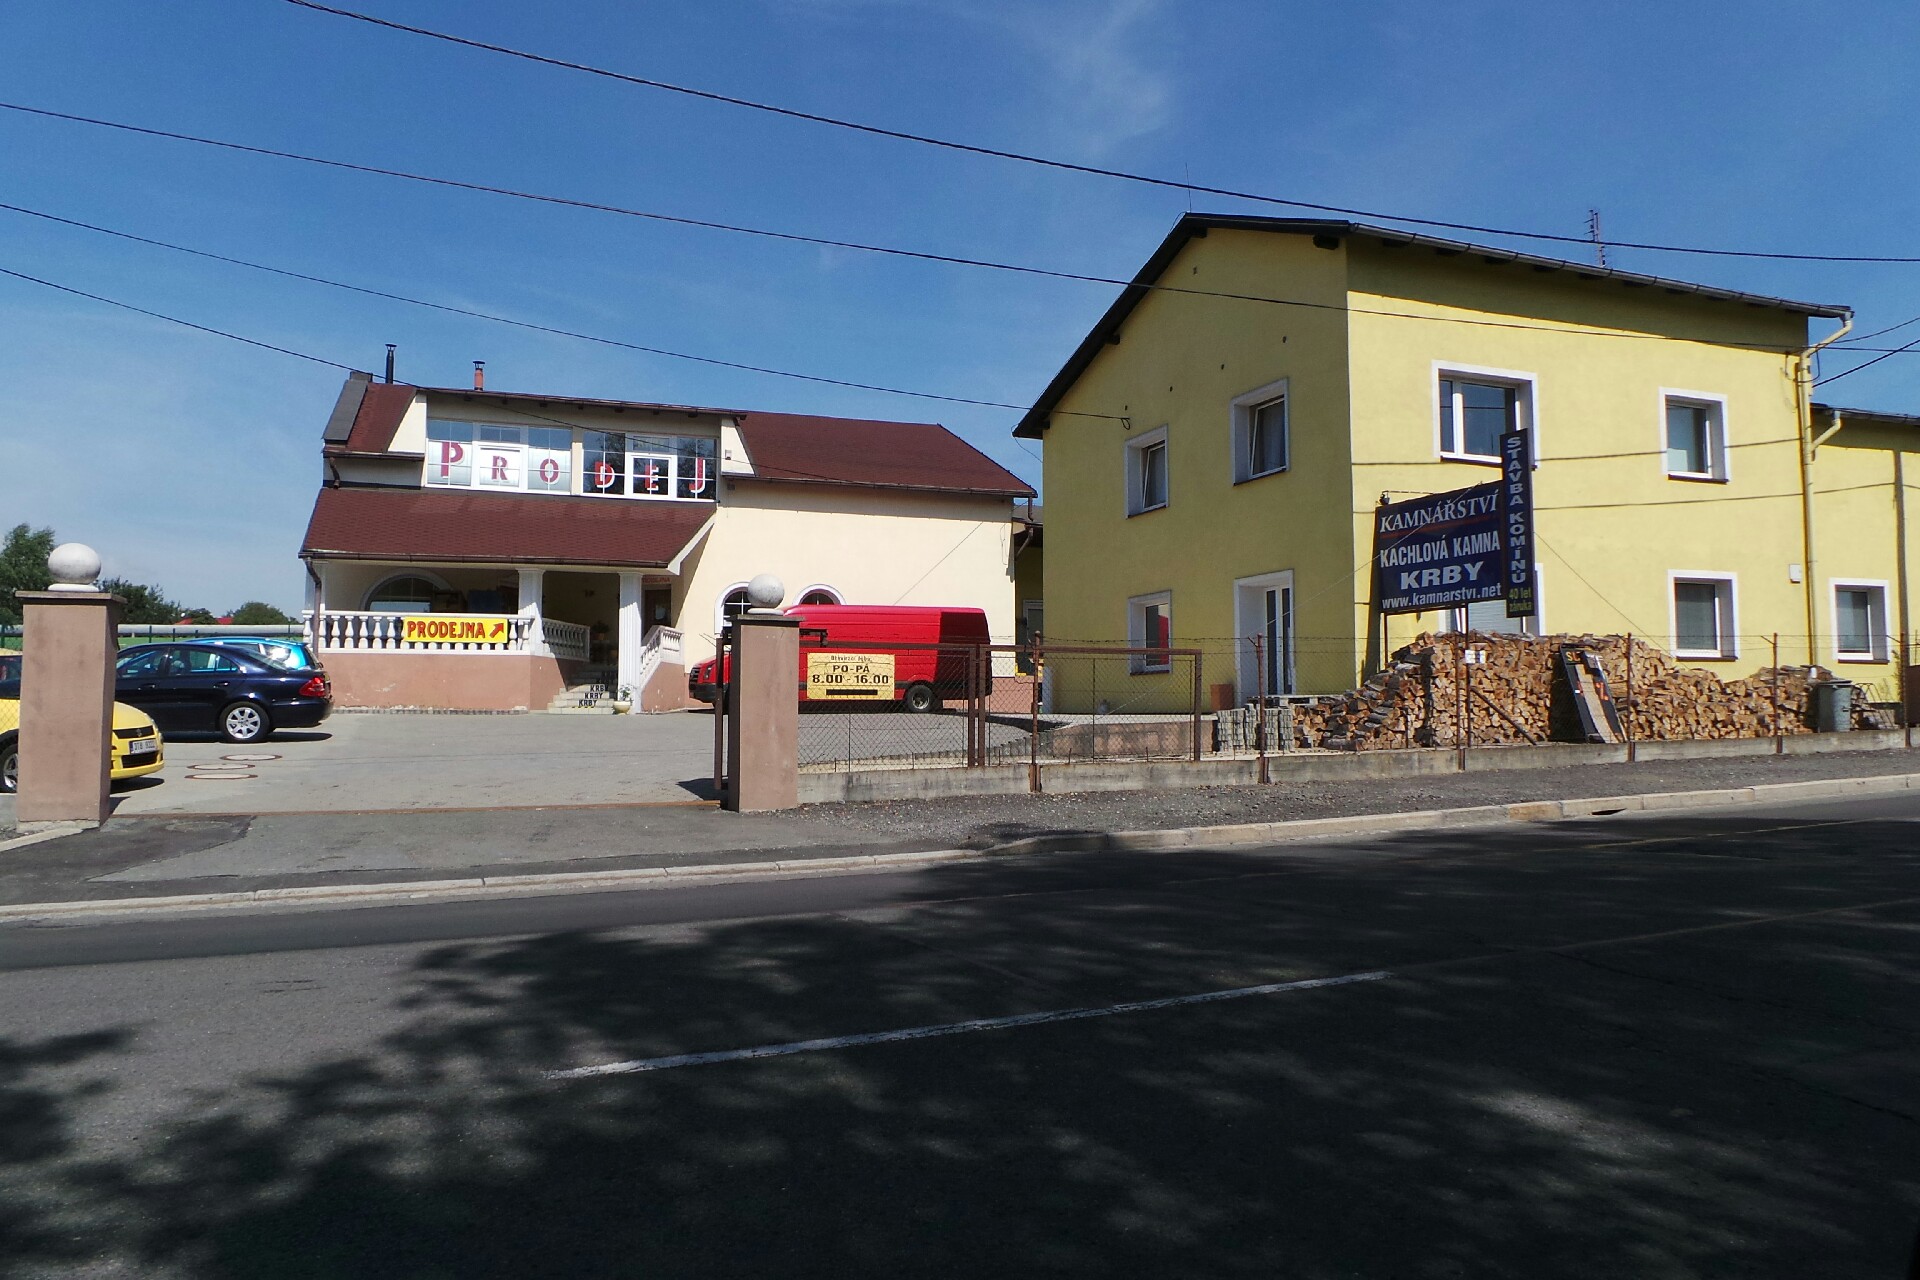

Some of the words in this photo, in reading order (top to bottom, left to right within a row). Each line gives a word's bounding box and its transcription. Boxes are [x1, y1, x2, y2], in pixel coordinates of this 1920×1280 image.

[440, 441, 706, 494] PRODEJ
[1507, 436, 1524, 506] STAVBA
[1379, 489, 1499, 533] KAMNÁŘSTVÍ
[1380, 534, 1449, 568] KACHLOVÁ
[1453, 530, 1501, 558] KAMNA
[1509, 511, 1526, 584] KOMÍNŮ
[1400, 561, 1484, 590] KRBY
[1381, 582, 1502, 609] www.kamnarstvi.net
[406, 620, 486, 639] PRODEJNA
[812, 674, 843, 684] 8.00
[854, 674, 889, 684] 16.00
